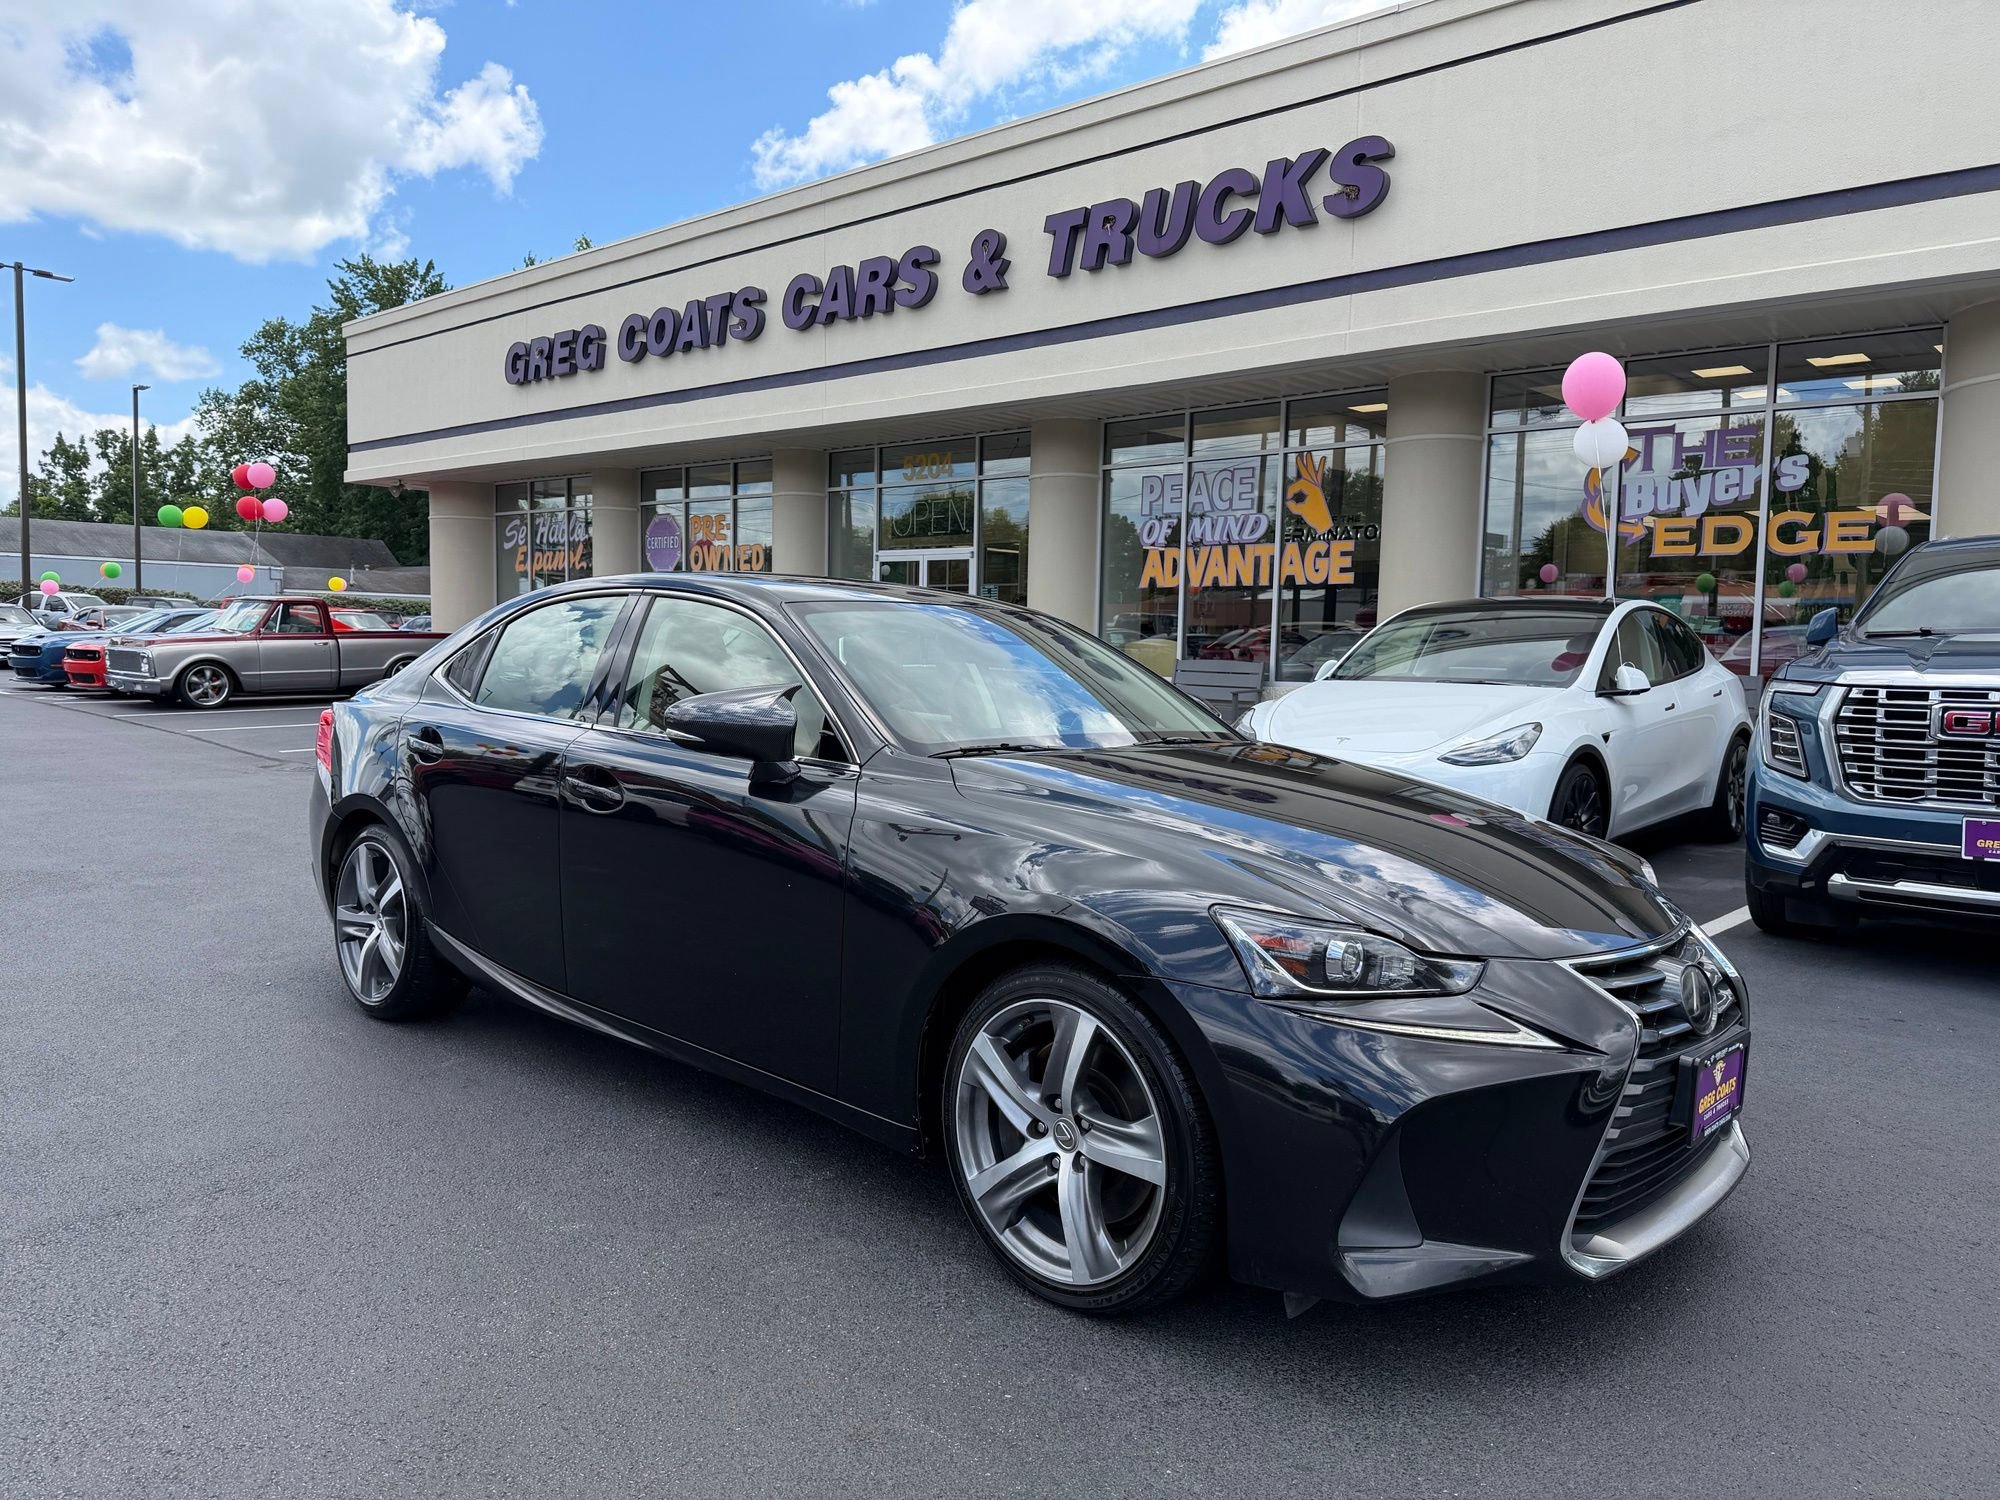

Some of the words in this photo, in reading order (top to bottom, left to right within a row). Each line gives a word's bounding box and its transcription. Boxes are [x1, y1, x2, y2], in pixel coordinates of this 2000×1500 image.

[505, 324, 606, 385] GREG
[618, 286, 767, 363] COATS
[781, 245, 940, 331] CARS
[962, 228, 1011, 295] &
[1043, 135, 1396, 278] TRUCKS
[902, 453, 954, 481] 5204
[1624, 424, 1758, 474] THE
[1141, 467, 1256, 516] PEACE
[1619, 454, 1809, 520] Buyer's
[504, 519, 527, 550] Se
[690, 514, 731, 541] PRE-
[893, 497, 968, 537] OPEN
[1139, 518, 1177, 547] OF
[1186, 513, 1269, 546] MIND
[1650, 510, 1877, 558] EDGE
[647, 535, 679, 549] CERTIFIED
[690, 544, 765, 572] OWNED
[1139, 540, 1355, 589] ADVANTAGE
[1944, 710, 2000, 736] G
[1698, 1089, 1716, 1114] GREG
[1716, 1076, 1737, 1101] COATS
